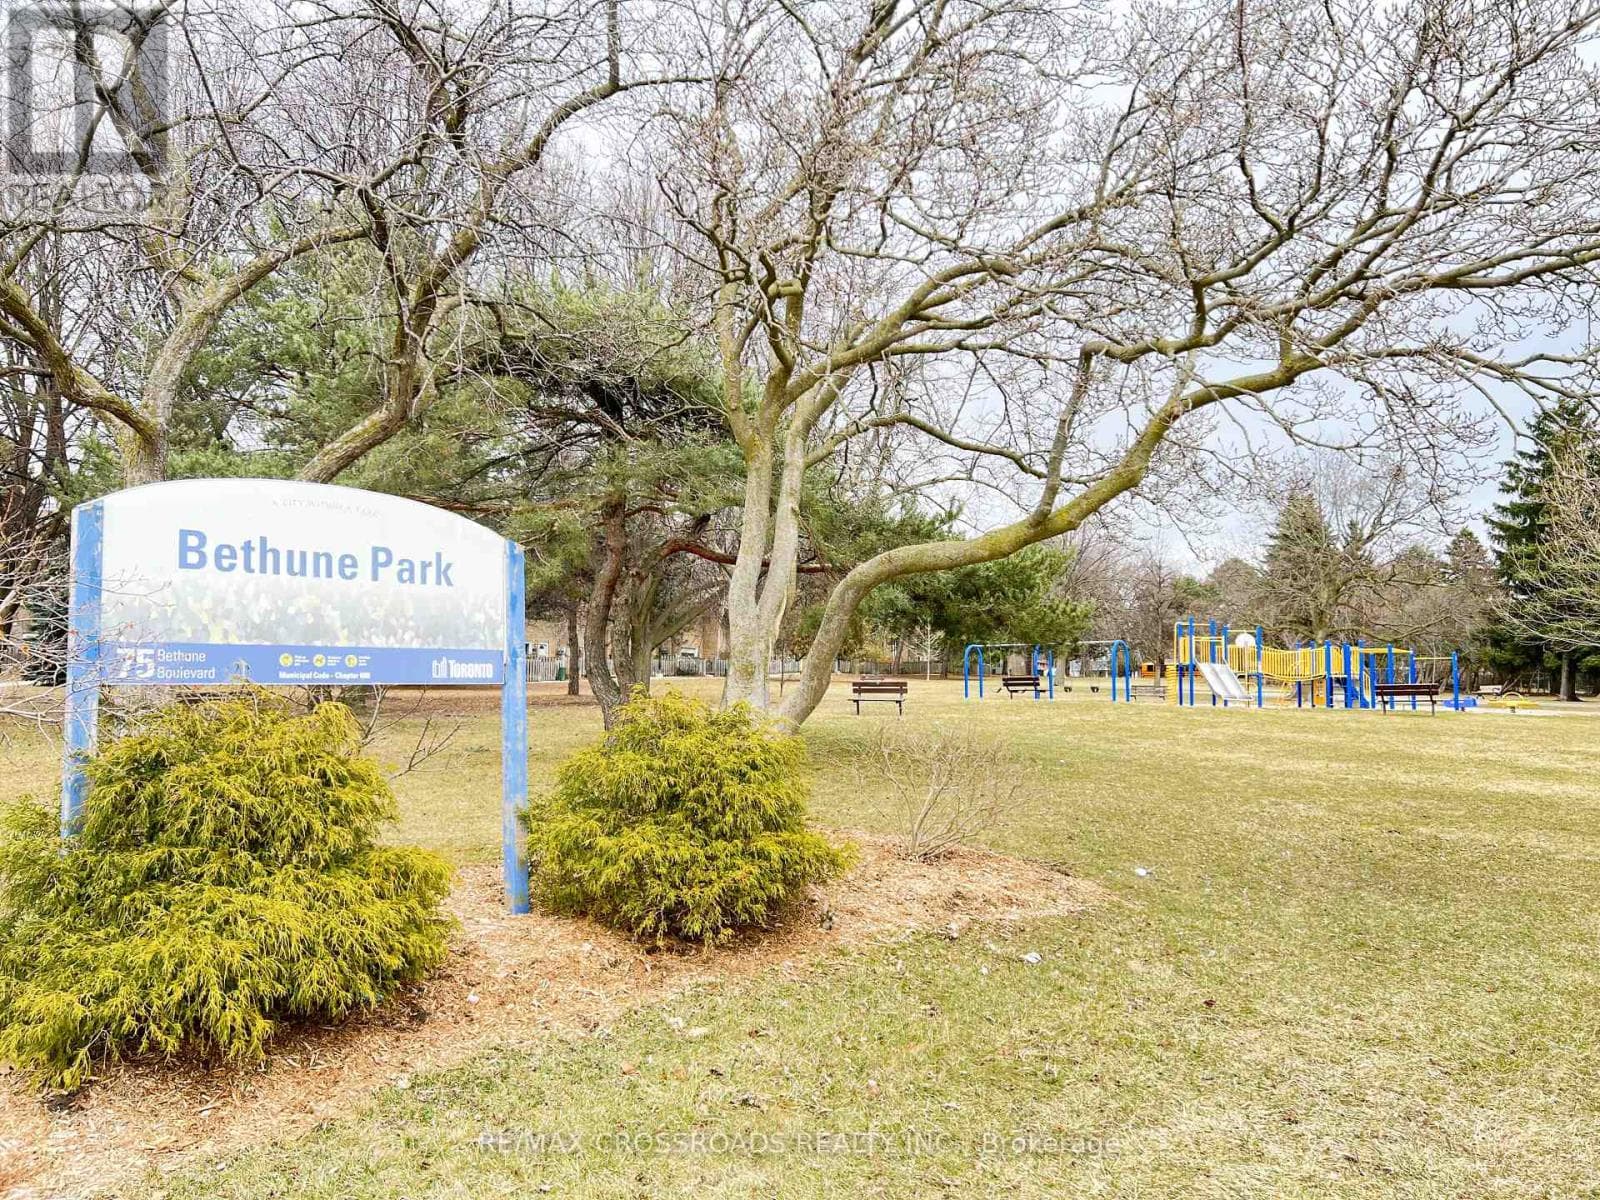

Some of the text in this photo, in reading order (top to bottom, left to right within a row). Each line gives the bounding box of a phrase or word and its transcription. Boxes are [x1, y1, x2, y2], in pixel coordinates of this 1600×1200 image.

[178, 529, 454, 587] Bethune Park
[116, 648, 156, 678] 75
[157, 650, 206, 662] Bethune
[157, 667, 216, 679] Boulevard
[313, 671, 330, 679] Code
[449, 660, 494, 679] TORONTO
